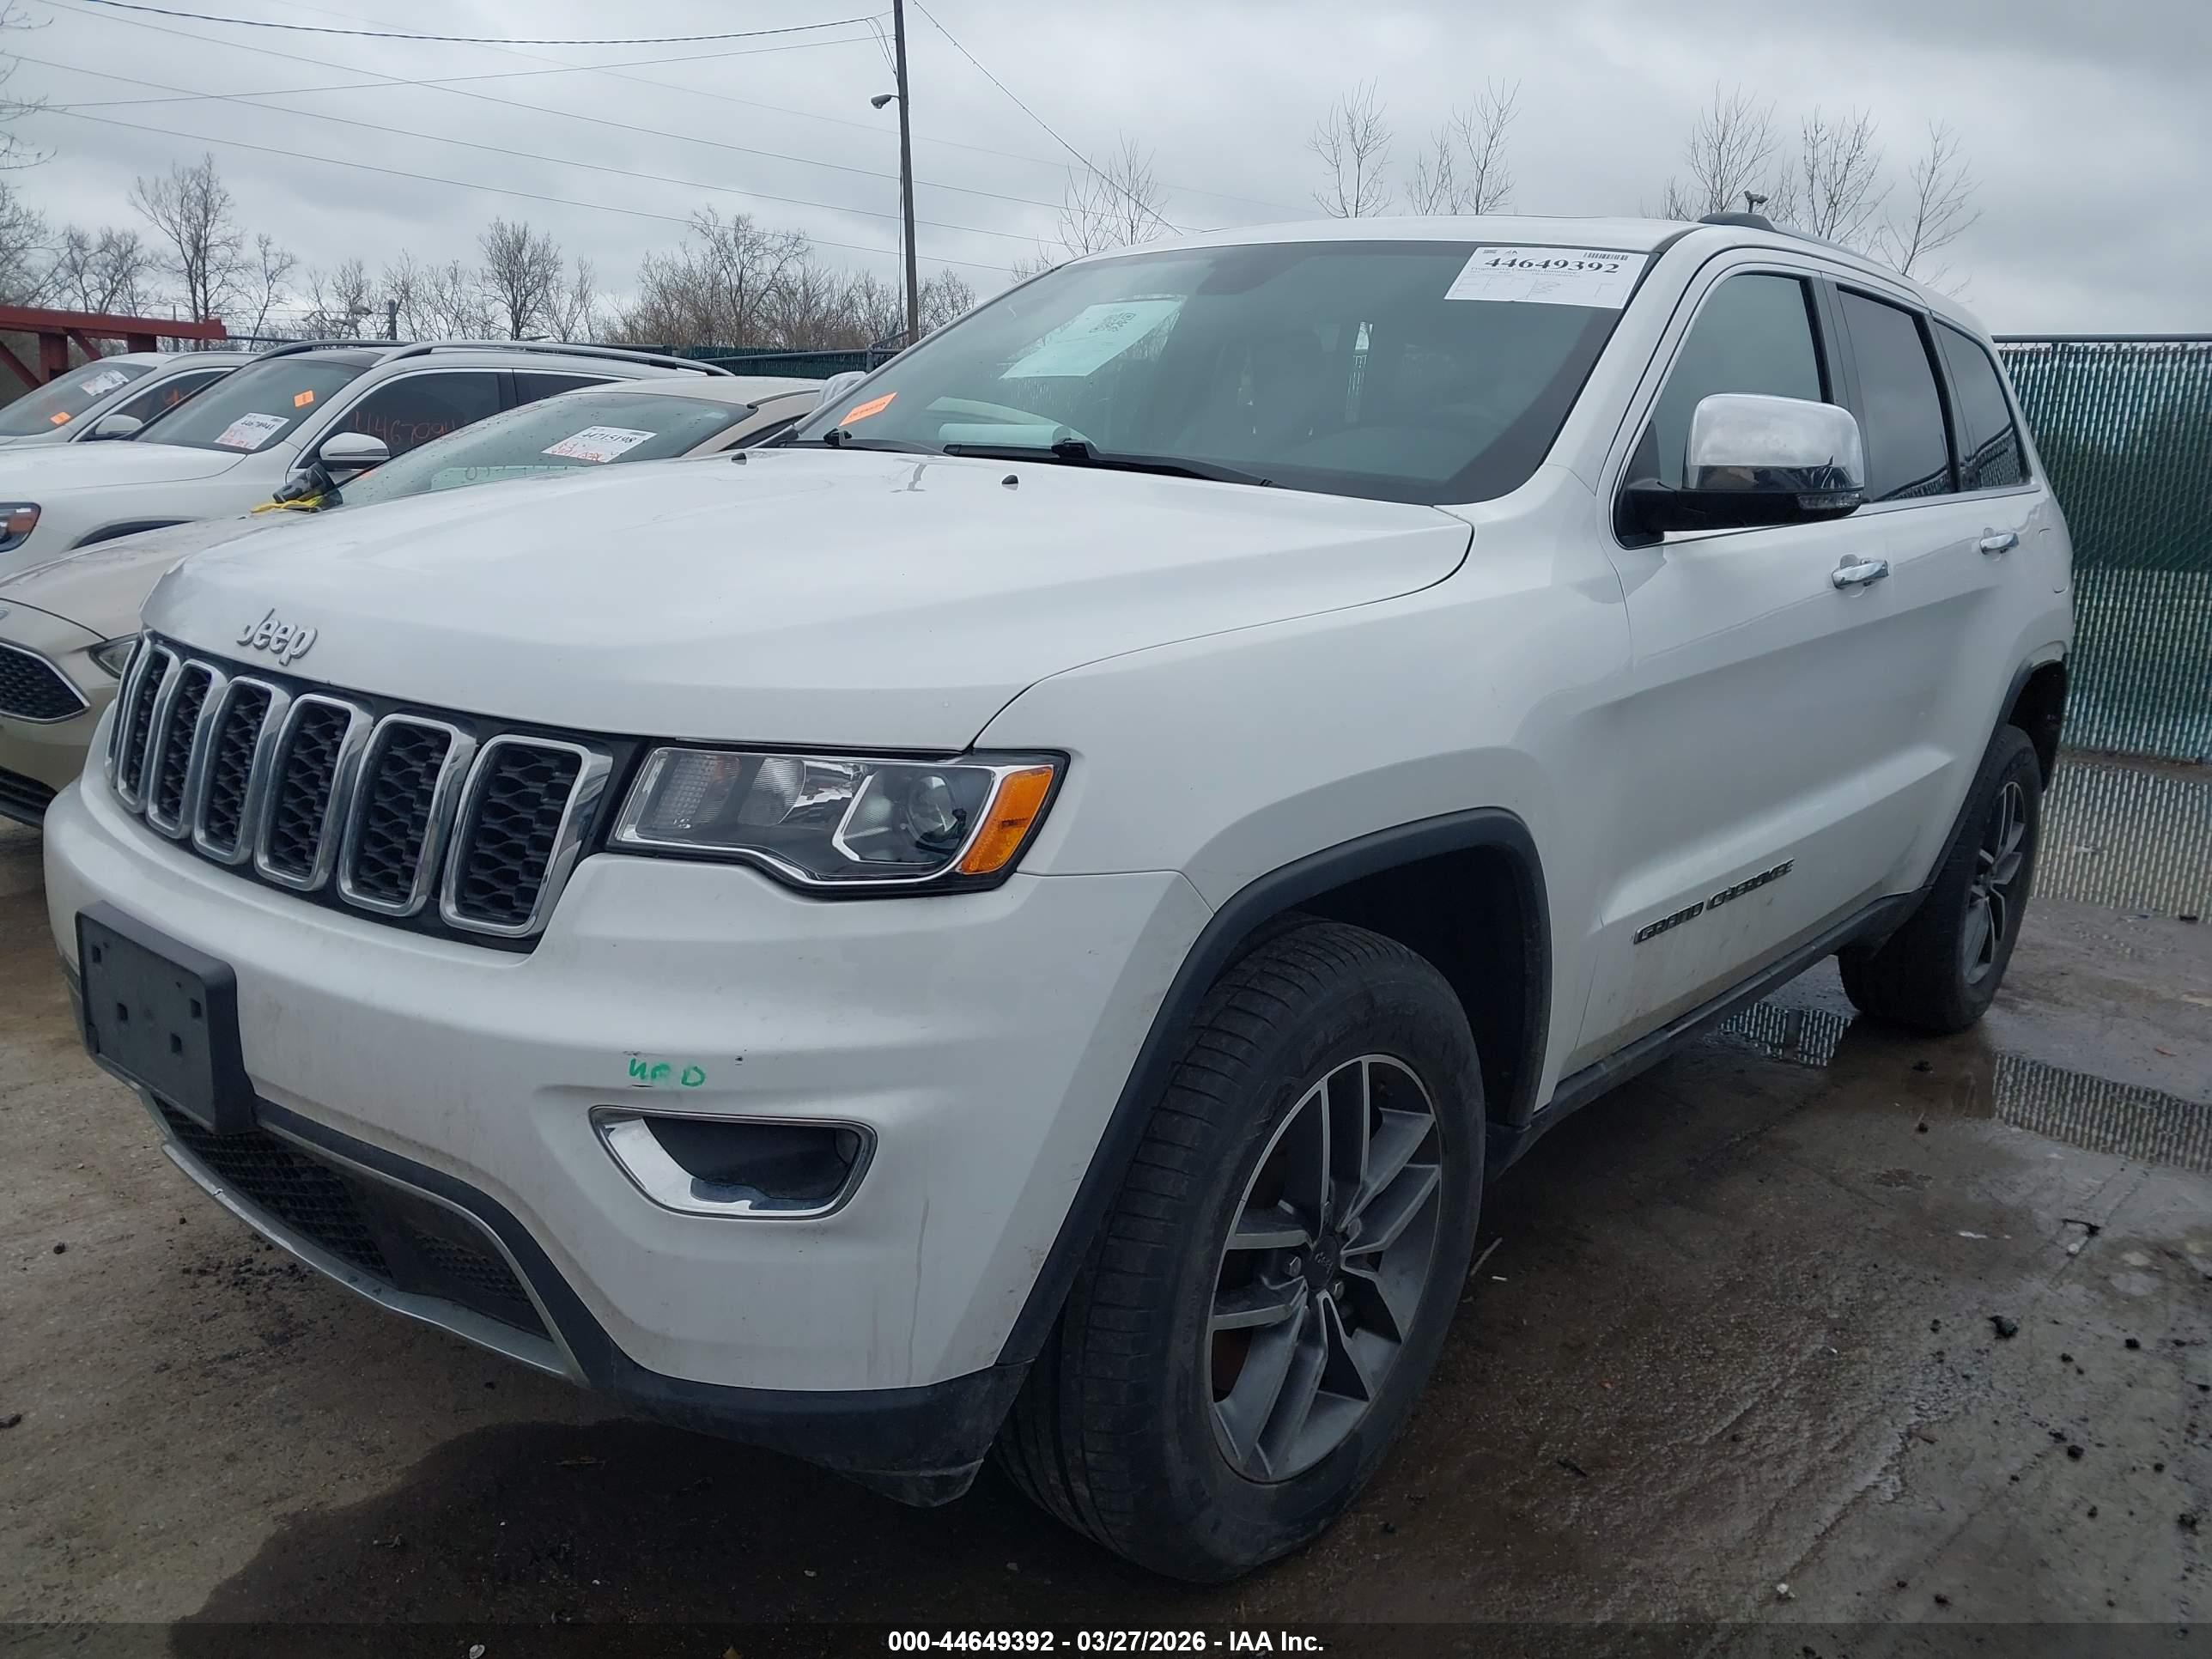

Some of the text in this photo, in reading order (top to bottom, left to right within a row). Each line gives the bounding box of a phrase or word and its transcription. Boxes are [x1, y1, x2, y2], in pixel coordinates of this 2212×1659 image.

[1485, 257, 1620, 274] 44649392
[236, 607, 319, 667] Jeep
[1633, 857, 1796, 945] GRAND CHEROKEE
